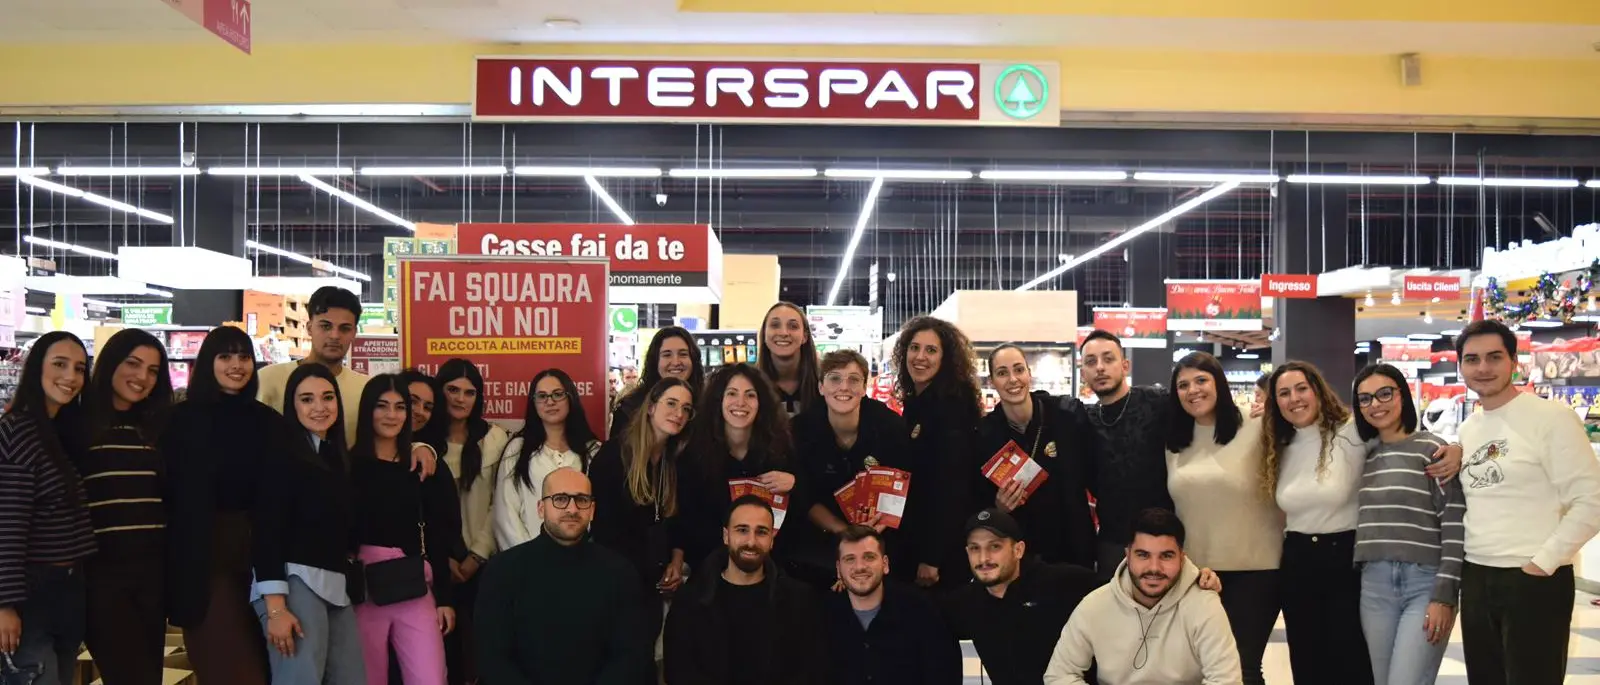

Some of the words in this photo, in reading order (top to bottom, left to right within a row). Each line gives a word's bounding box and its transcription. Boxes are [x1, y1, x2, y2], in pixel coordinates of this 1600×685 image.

[510, 66, 974, 109] INTERSPAR
[481, 233, 562, 256] Casse
[571, 233, 606, 257] fai
[615, 233, 649, 260] da
[657, 236, 685, 260] te
[608, 273, 682, 285] onomamente
[1268, 280, 1311, 292] Ingresso
[1406, 281, 1432, 291] Uscita
[1433, 281, 1460, 291] Clienti
[414, 272, 455, 301] FAI
[466, 272, 593, 307] SQUADRA
[450, 306, 503, 336] CON
[514, 306, 558, 336] NOI
[430, 340, 497, 352] RACCOLTA
[500, 339, 578, 351] ALIMENTARE
